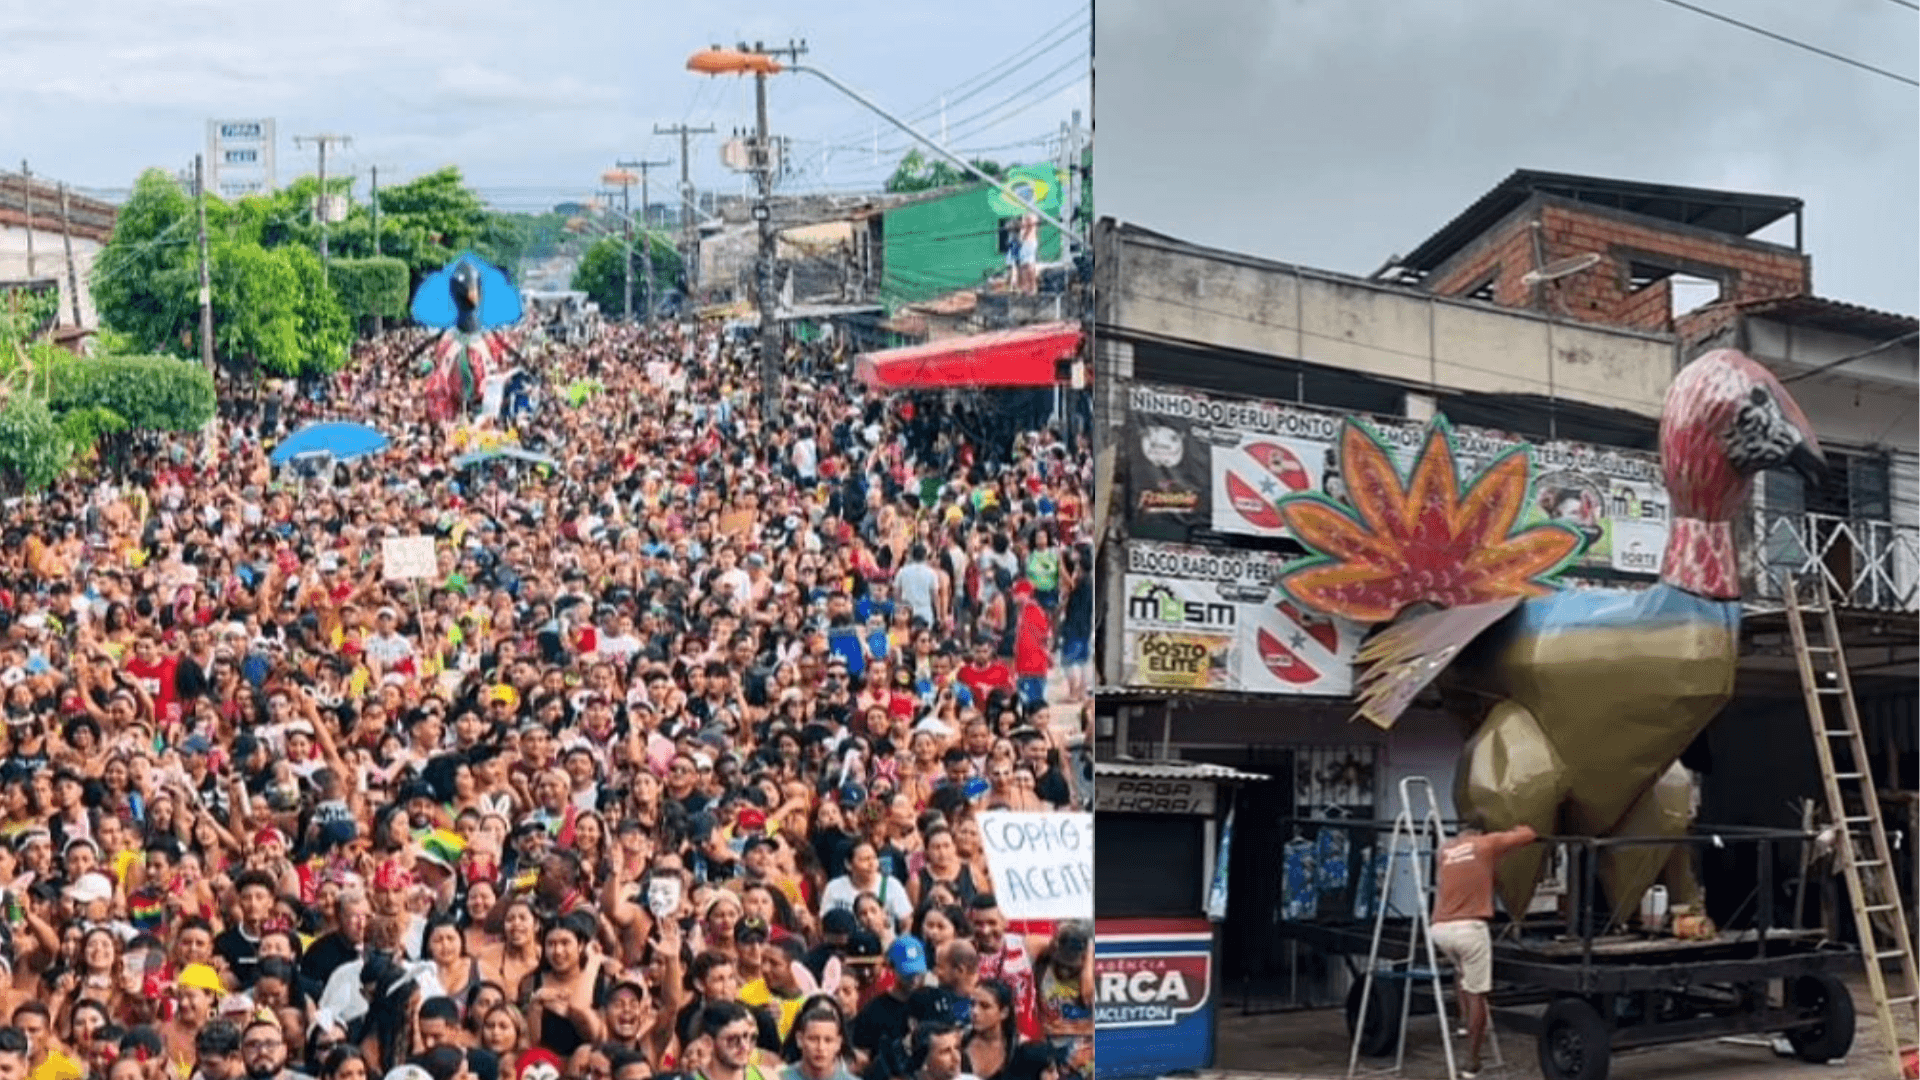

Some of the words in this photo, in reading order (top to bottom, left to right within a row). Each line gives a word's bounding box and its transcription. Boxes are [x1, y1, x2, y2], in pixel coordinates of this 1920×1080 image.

[1133, 393, 1193, 416] NINHO
[1199, 402, 1223, 421] DO
[1228, 406, 1271, 428] PERU
[1277, 414, 1334, 436] PONTO
[1132, 550, 1179, 572] BLOCO
[1182, 556, 1218, 576] RABO
[1222, 559, 1243, 578] DO
[1246, 561, 1279, 580] PERU
[1143, 641, 1207, 659] POSTO
[1149, 656, 1199, 673] ELITE
[1116, 781, 1192, 796] PAGA
[1095, 969, 1190, 1003] RCA
